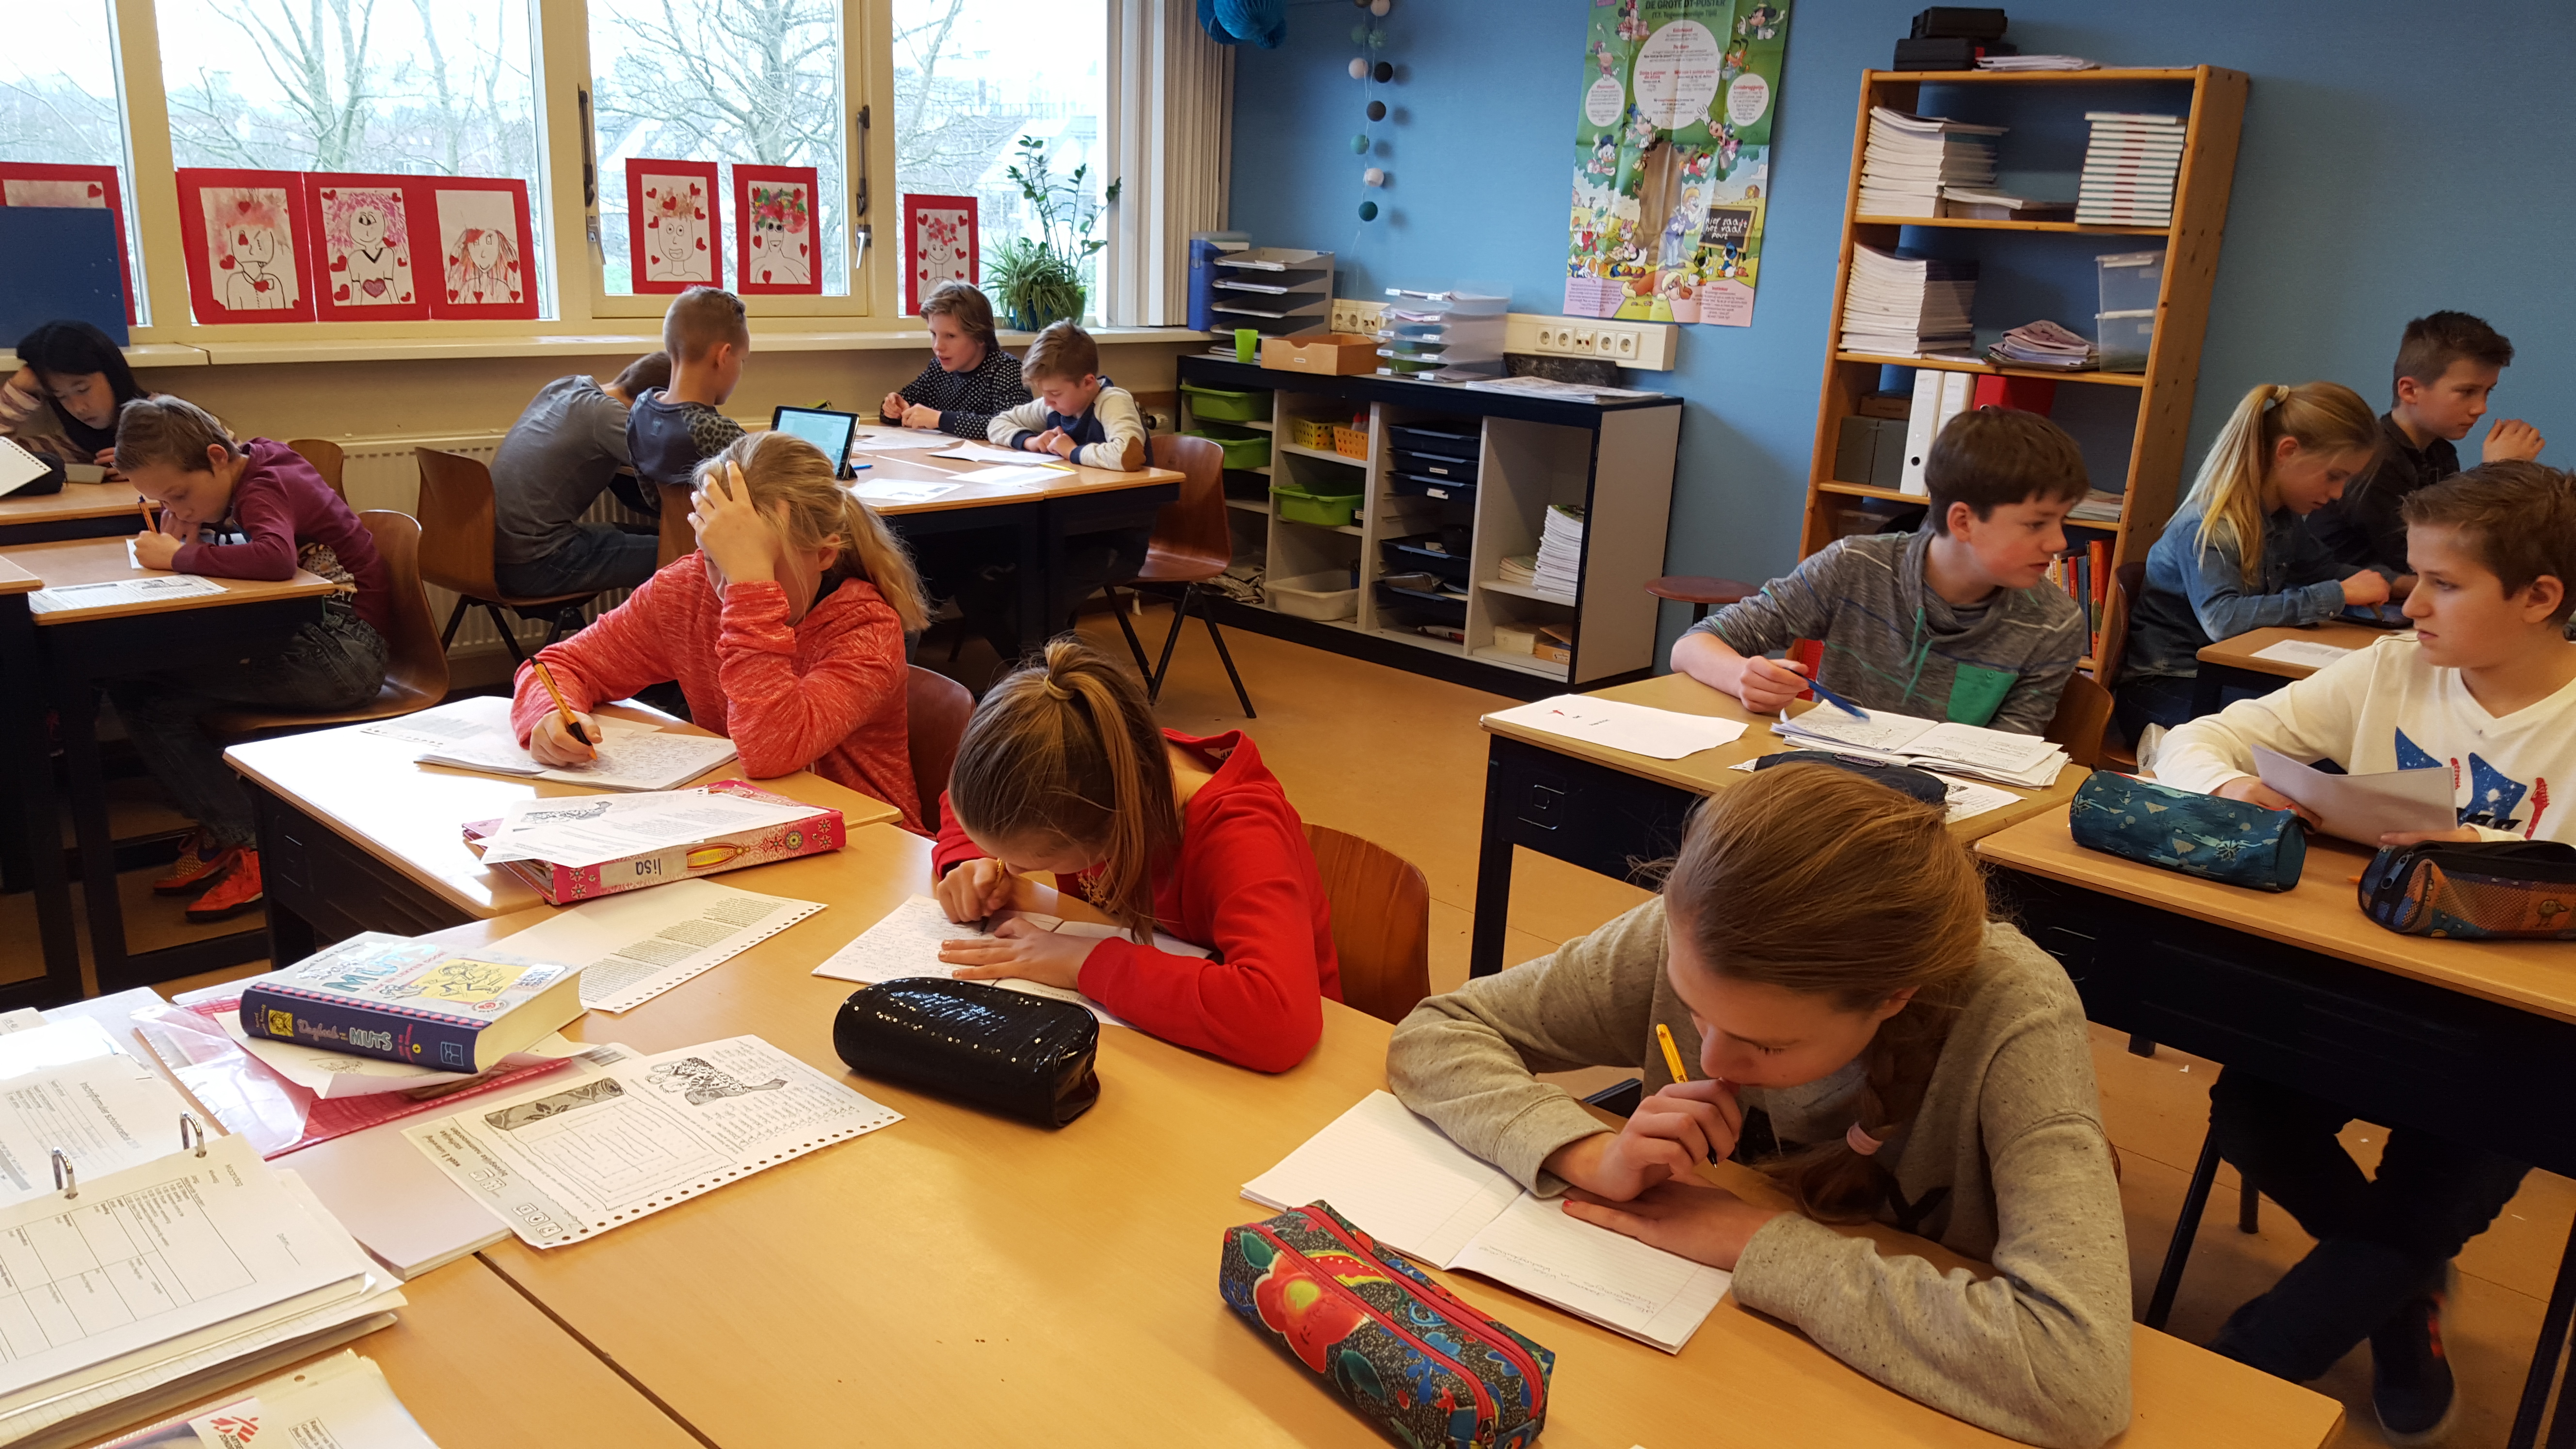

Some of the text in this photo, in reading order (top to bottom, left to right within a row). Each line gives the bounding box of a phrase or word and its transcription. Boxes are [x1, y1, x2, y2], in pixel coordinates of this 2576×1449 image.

[1645, 1, 1653, 9] DE
[1656, 0, 1681, 9] GROTE
[1706, 225, 1718, 233] het
[635, 857, 662, 876] lisa
[322, 943, 437, 993] MUTS
[349, 1027, 392, 1051] MUTS
